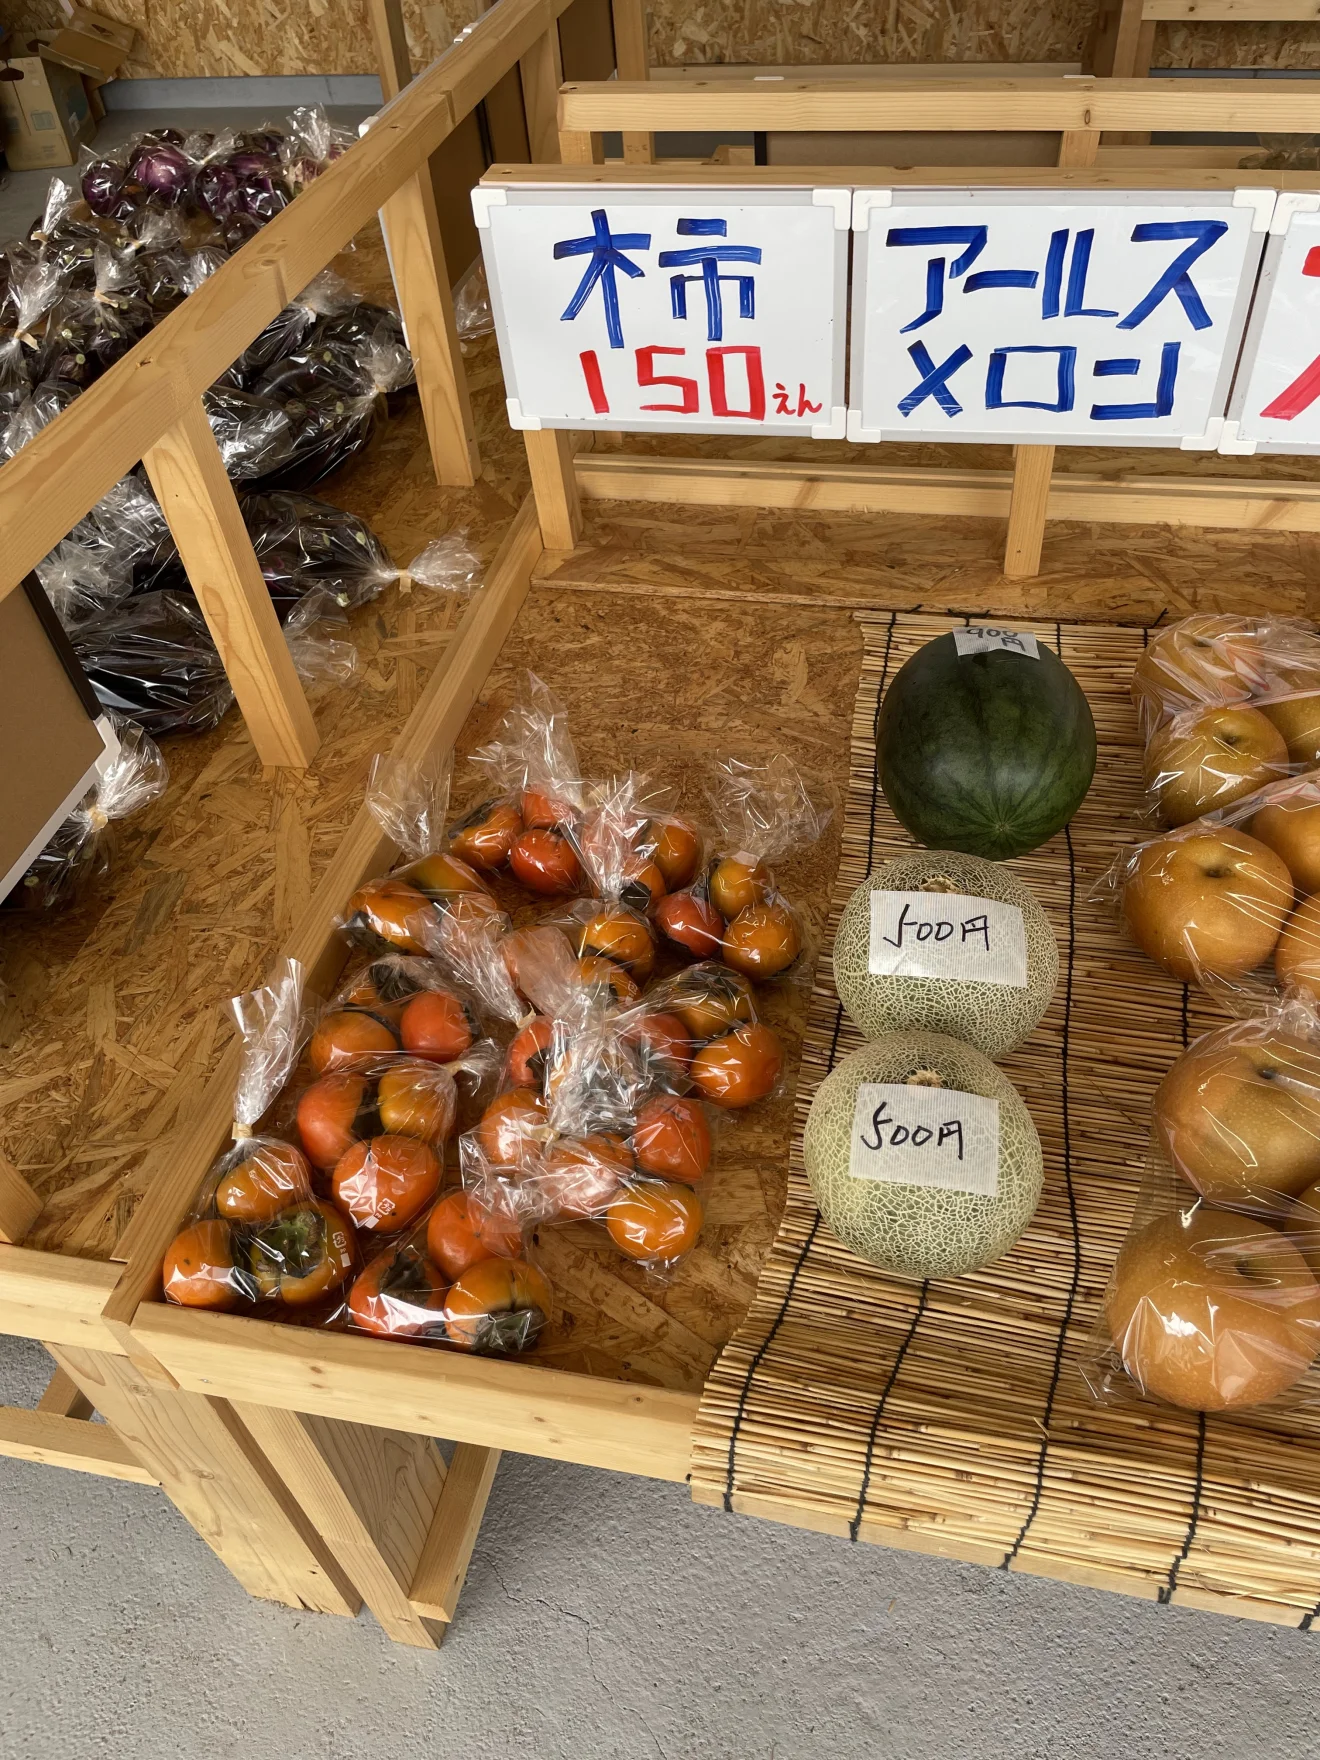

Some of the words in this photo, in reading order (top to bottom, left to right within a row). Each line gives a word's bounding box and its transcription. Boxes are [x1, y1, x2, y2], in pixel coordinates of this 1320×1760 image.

[553, 208, 762, 349] 柿
[886, 219, 1229, 334] アールス
[897, 340, 1182, 421] メロン
[882, 903, 989, 951] 500円
[860, 1101, 963, 1160] 500円
